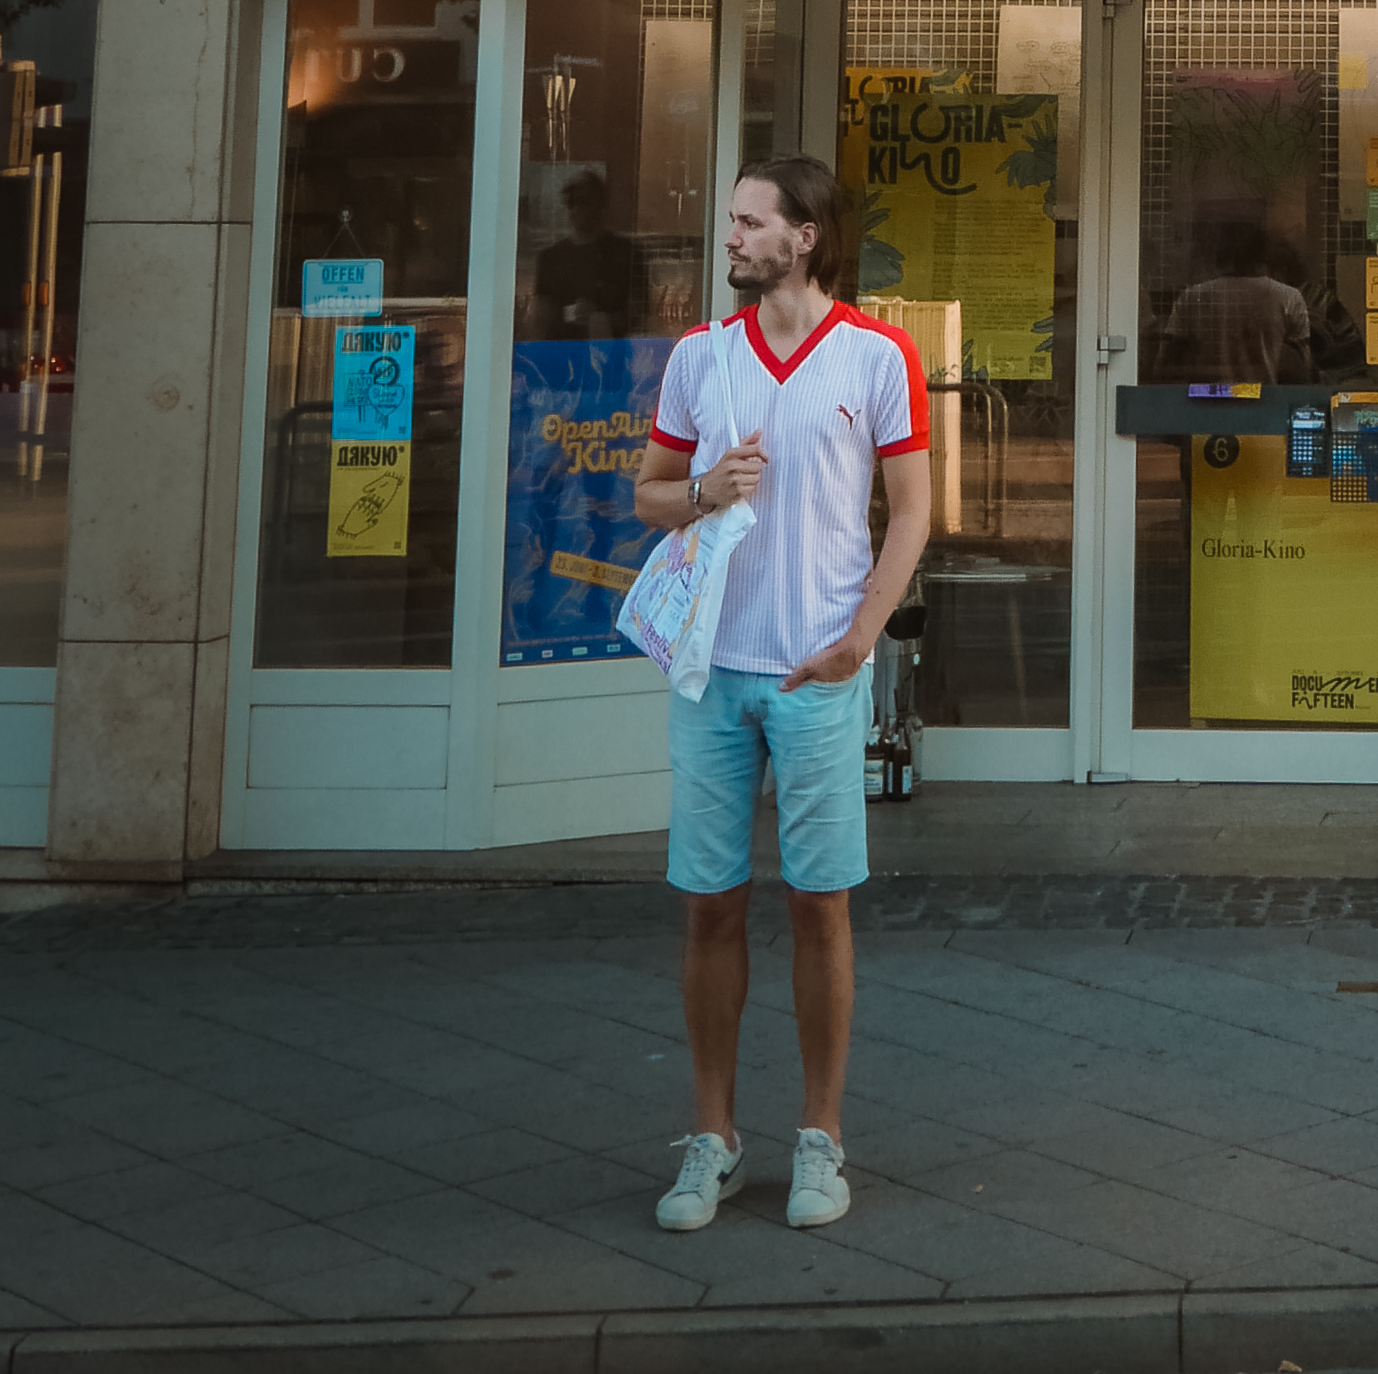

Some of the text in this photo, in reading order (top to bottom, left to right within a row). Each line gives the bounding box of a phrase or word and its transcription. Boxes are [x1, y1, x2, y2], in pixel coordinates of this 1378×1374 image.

[869, 101, 1024, 145] GLORIA-
[867, 134, 978, 196] KINO
[321, 267, 365, 281] OFFEN
[1212, 438, 1229, 462] 6
[1202, 538, 1306, 560] Gloria-Kino
[1291, 691, 1355, 710] FIFTEEN
